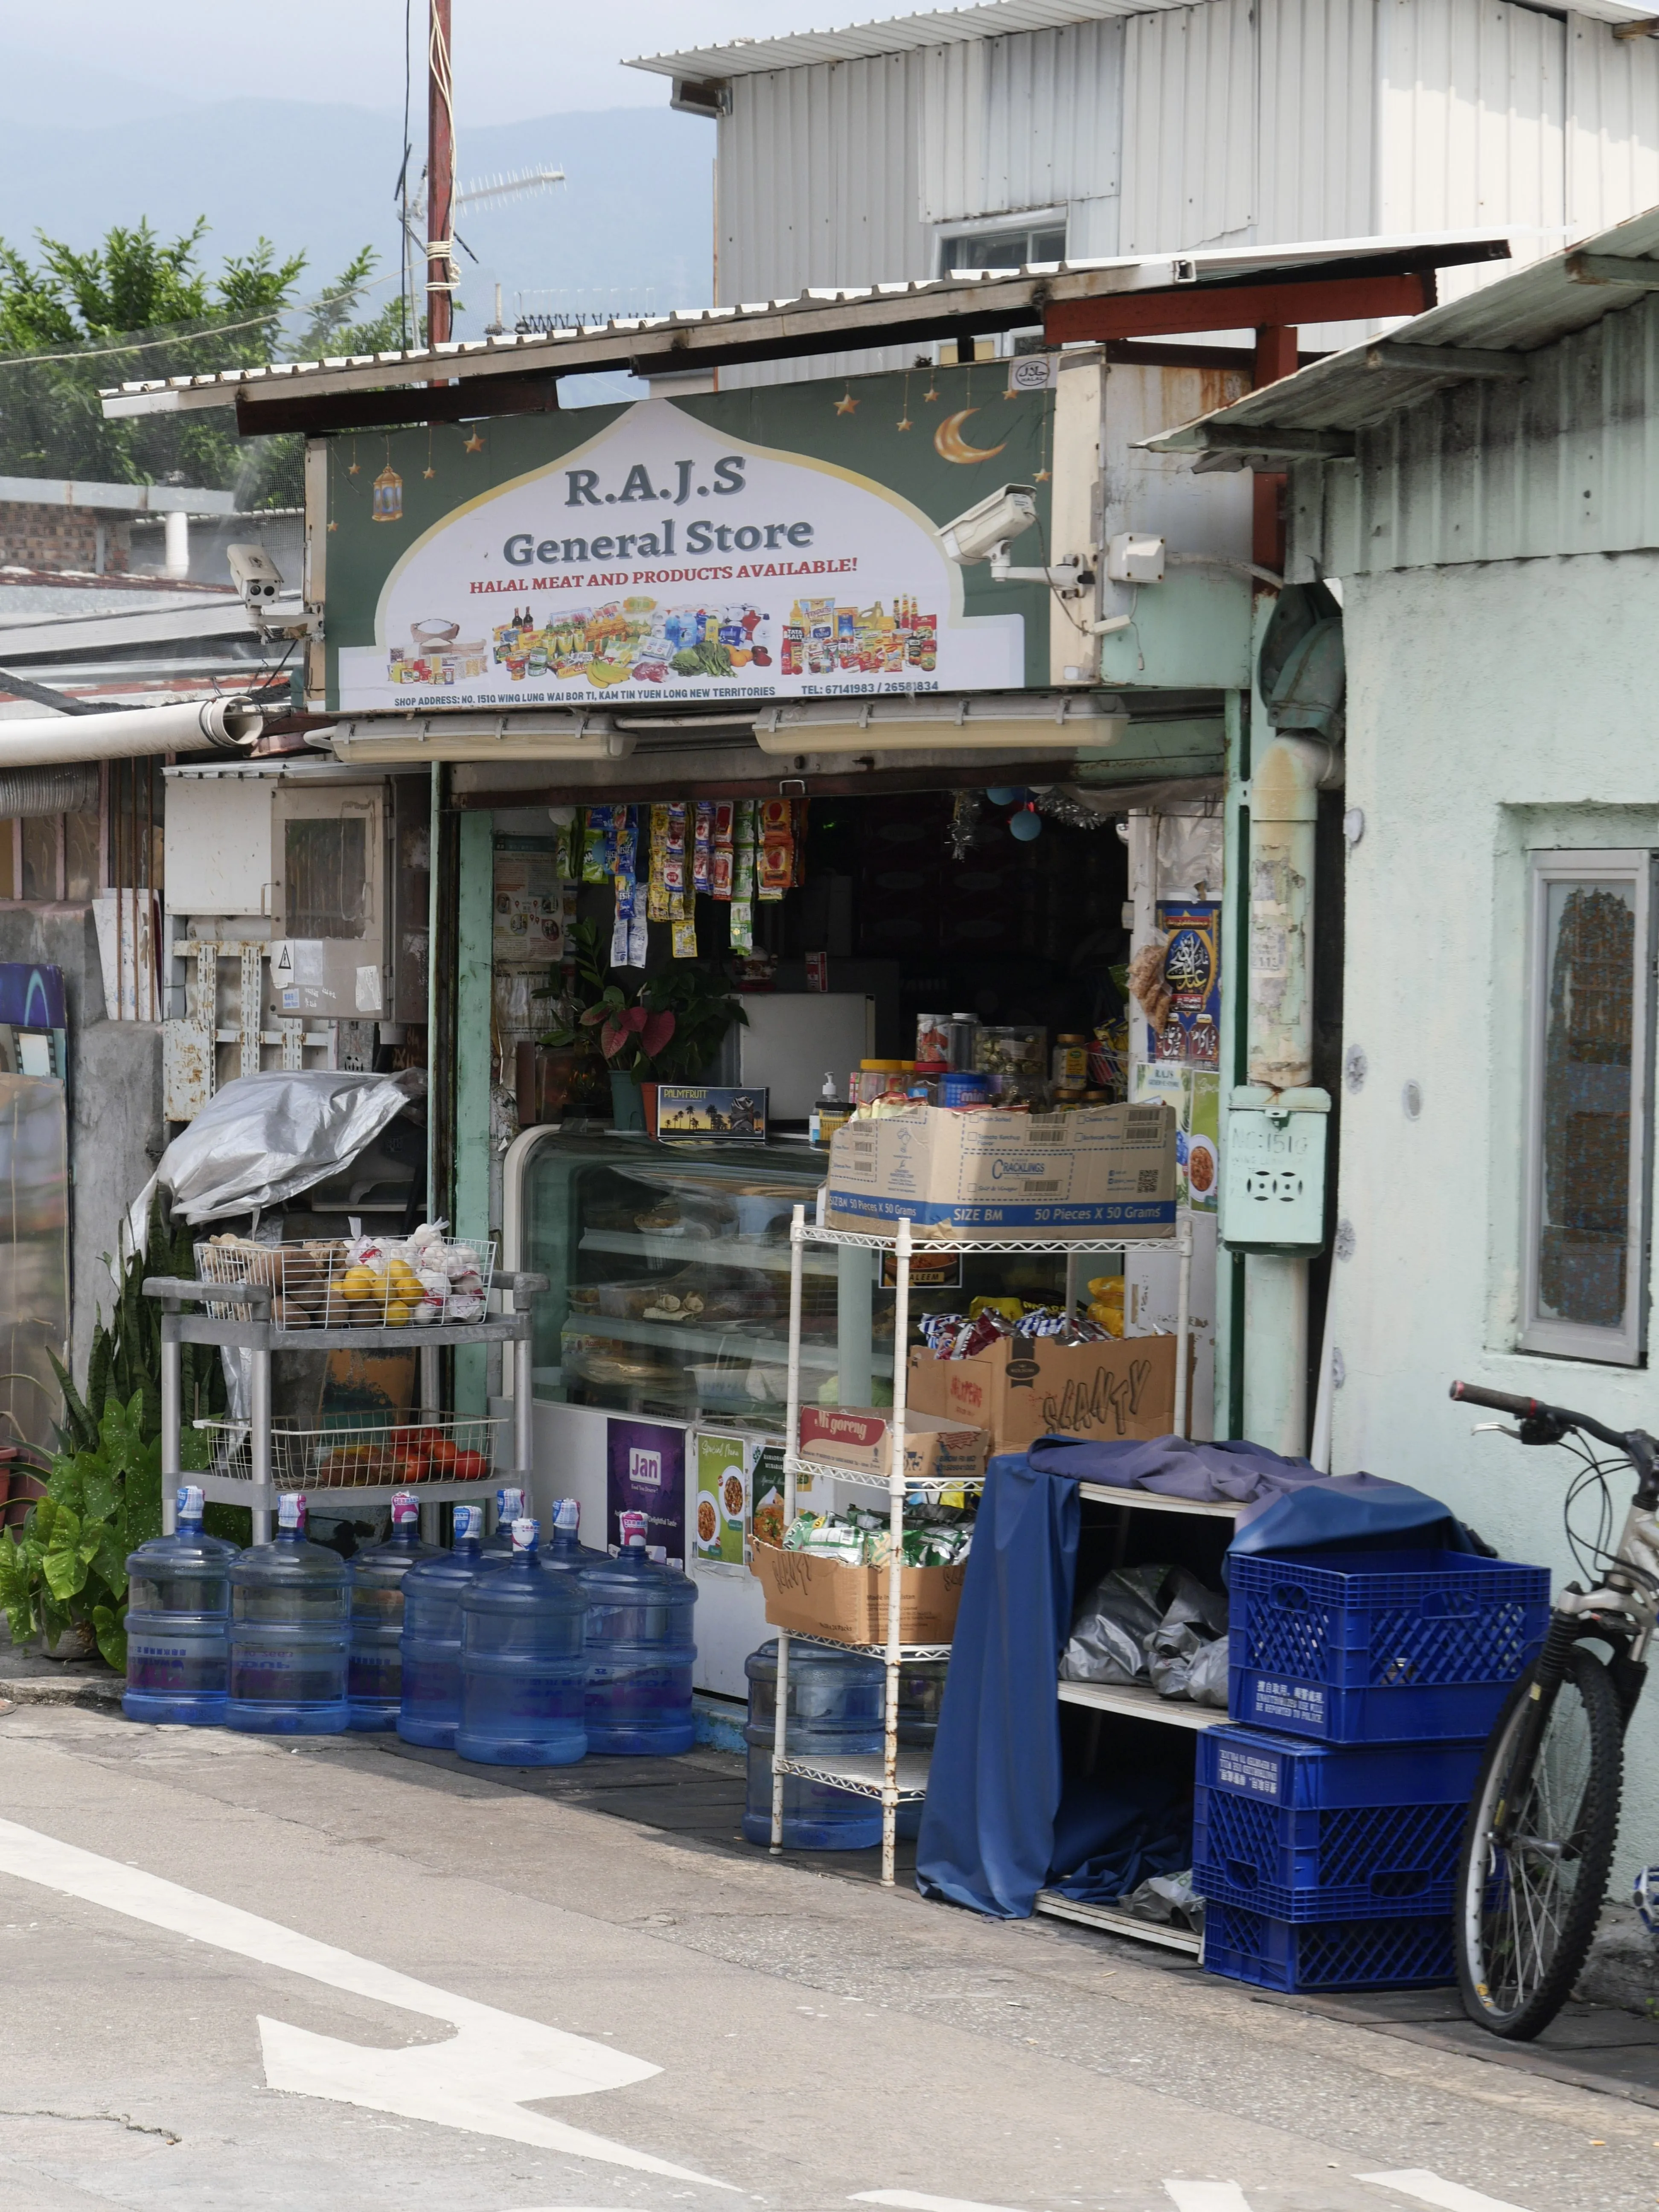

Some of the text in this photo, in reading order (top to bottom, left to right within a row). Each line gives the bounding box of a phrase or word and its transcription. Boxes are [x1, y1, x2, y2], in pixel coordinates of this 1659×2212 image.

[565, 456, 746, 506] R.A.J.S
[504, 518, 814, 566] General Store
[469, 557, 857, 594] HALAL MEAT AND PRODUCTS AVAILABLE!
[395, 698, 416, 706] SHOP
[418, 696, 460, 705] ADDRESS:
[462, 695, 475, 704] NO.
[498, 693, 520, 702] WING
[522, 693, 544, 701] LUNG
[547, 692, 564, 701] WAI
[566, 691, 583, 700] BOR
[586, 691, 597, 701] TI,
[599, 690, 617, 699] KAM
[621, 690, 634, 699] TIN
[637, 689, 661, 699] YUEN
[664, 689, 687, 698] LONG
[690, 688, 710, 697] NEW
[713, 686, 775, 696] TERRITORIES
[801, 685, 823, 694] TEL:
[825, 684, 874, 694] 67141983
[885, 681, 938, 692] 26581834
[850, 1199, 857, 1209] 50
[859, 1200, 877, 1212] Pieces
[879, 1203, 883, 1212] X
[885, 1204, 894, 1214] 50
[895, 1205, 917, 1216] Grams
[953, 1206, 1161, 1221] SIZE BM 50 Pieces X 50 Grams
[815, 1410, 867, 1441] Mi goreng
[632, 1453, 658, 1479] Jan
[666, 1519, 677, 1528] Taste
